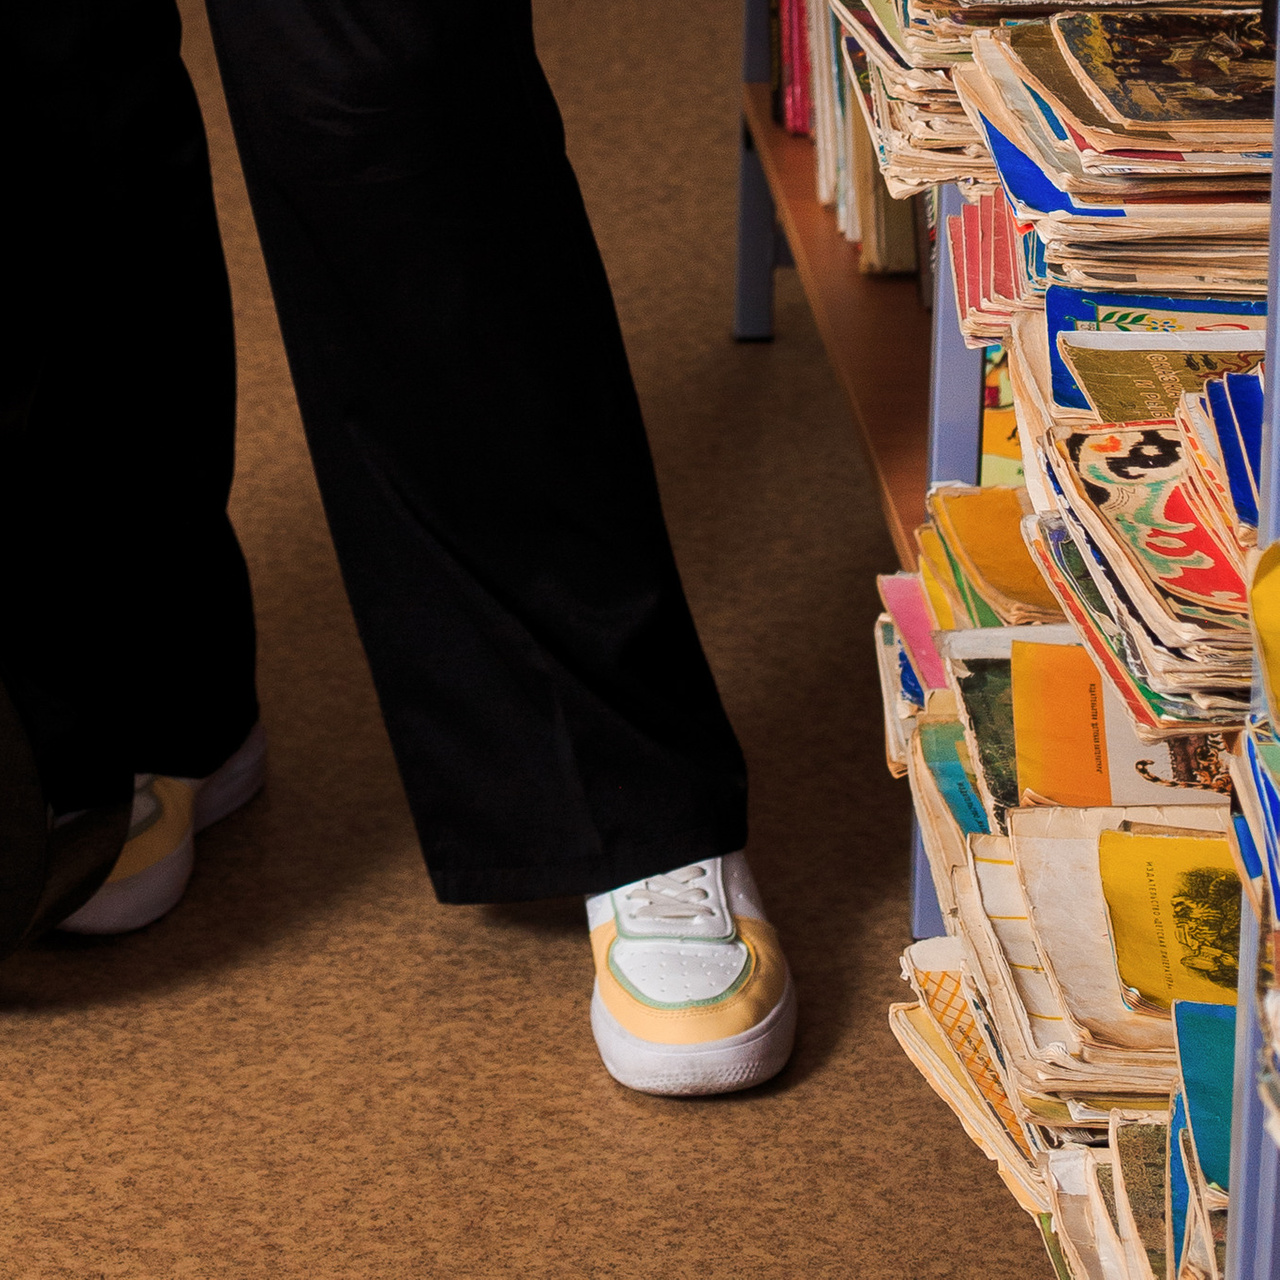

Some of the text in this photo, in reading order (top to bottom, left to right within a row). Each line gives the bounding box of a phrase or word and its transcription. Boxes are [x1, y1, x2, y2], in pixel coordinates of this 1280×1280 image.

[1132, 379, 1157, 389] И
[1146, 353, 1184, 399] СКАЗКА
[1088, 683, 1098, 721] ИЗДАТЕЛЬСТВО
[1146, 861, 1162, 916] ИЗДАТЕЛЬСТВО
